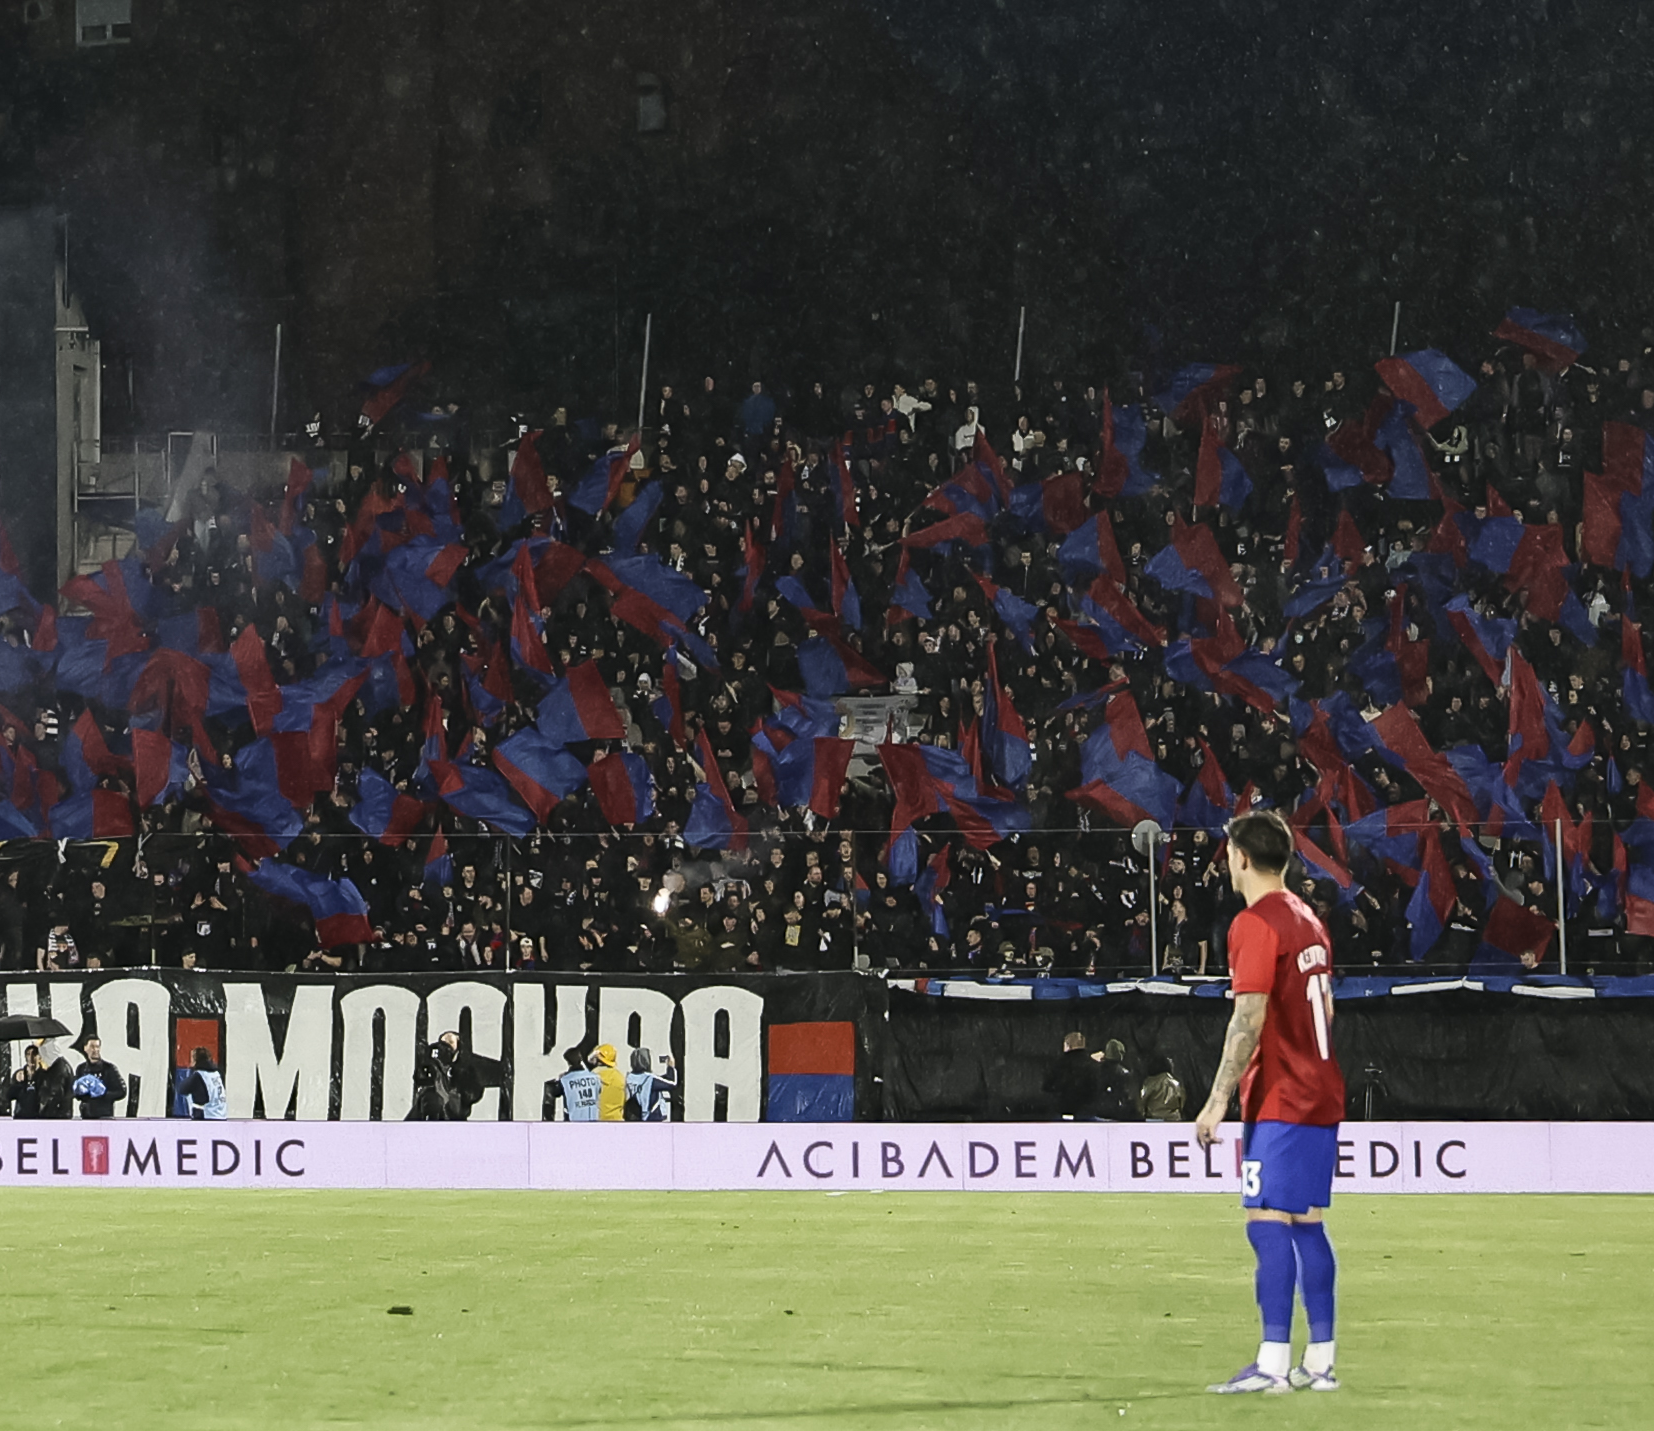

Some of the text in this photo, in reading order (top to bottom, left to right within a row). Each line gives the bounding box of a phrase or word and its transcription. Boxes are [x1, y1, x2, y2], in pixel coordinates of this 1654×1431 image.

[1306, 973, 1330, 1061] 1
[569, 1076, 596, 1090] PHOTO
[122, 1136, 305, 1178] MEDIC
[756, 1138, 1468, 1181] ACIBADEM BEL EDIC
